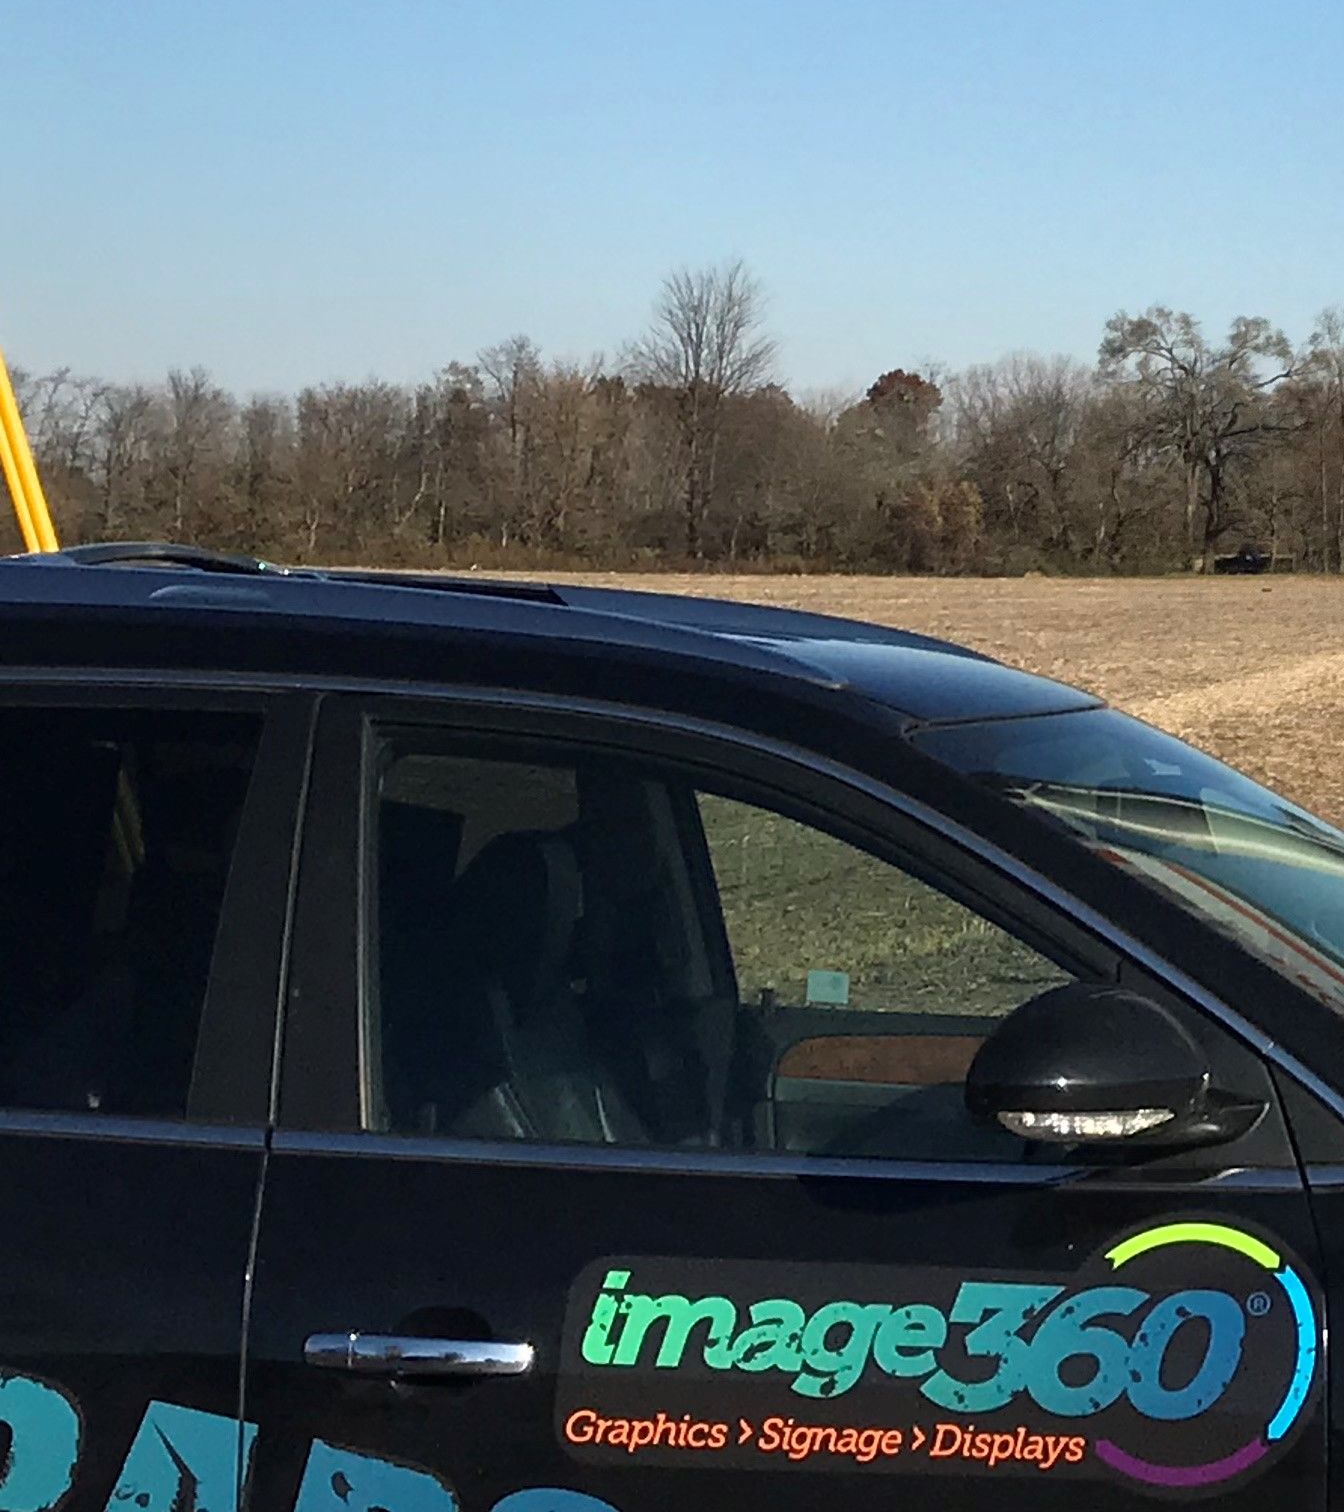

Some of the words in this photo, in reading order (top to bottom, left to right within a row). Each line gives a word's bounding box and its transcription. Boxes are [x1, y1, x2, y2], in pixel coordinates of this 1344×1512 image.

[565, 1409, 729, 1450] Graphics
[758, 1416, 903, 1459] Signage
[929, 1423, 1086, 1464] Displays
